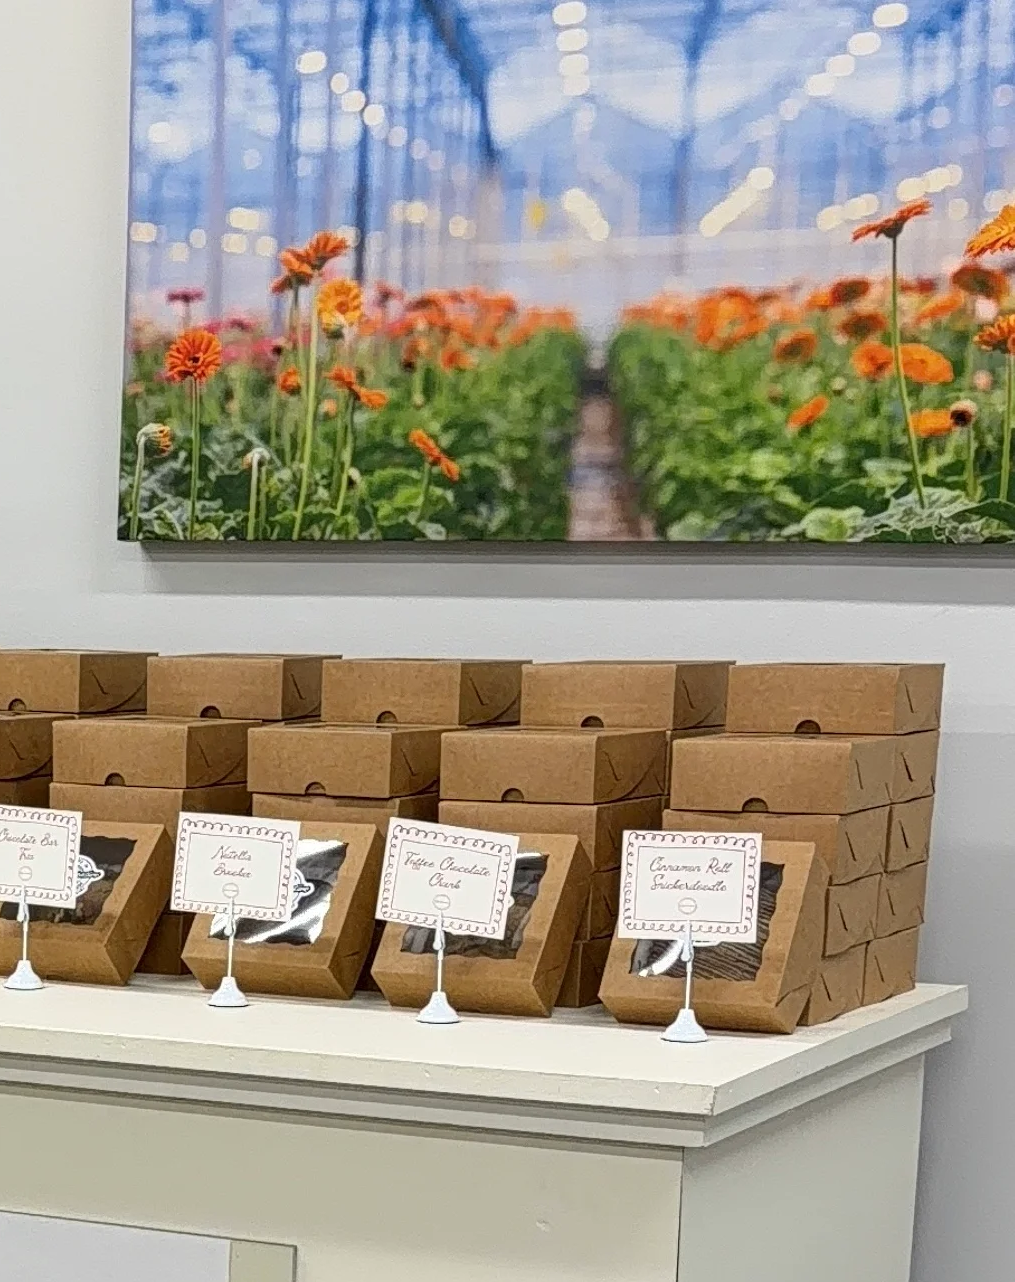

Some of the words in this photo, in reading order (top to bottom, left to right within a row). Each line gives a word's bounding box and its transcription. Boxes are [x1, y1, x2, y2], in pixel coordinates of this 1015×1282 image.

[210, 845, 252, 862] Nutella
[403, 851, 435, 870] Toffee
[439, 856, 491, 877] Chocolate
[649, 856, 702, 873] Cinnamon
[705, 857, 733, 875] Roll
[428, 872, 462, 890] Chunk
[650, 874, 727, 892] Snickerdoodle
